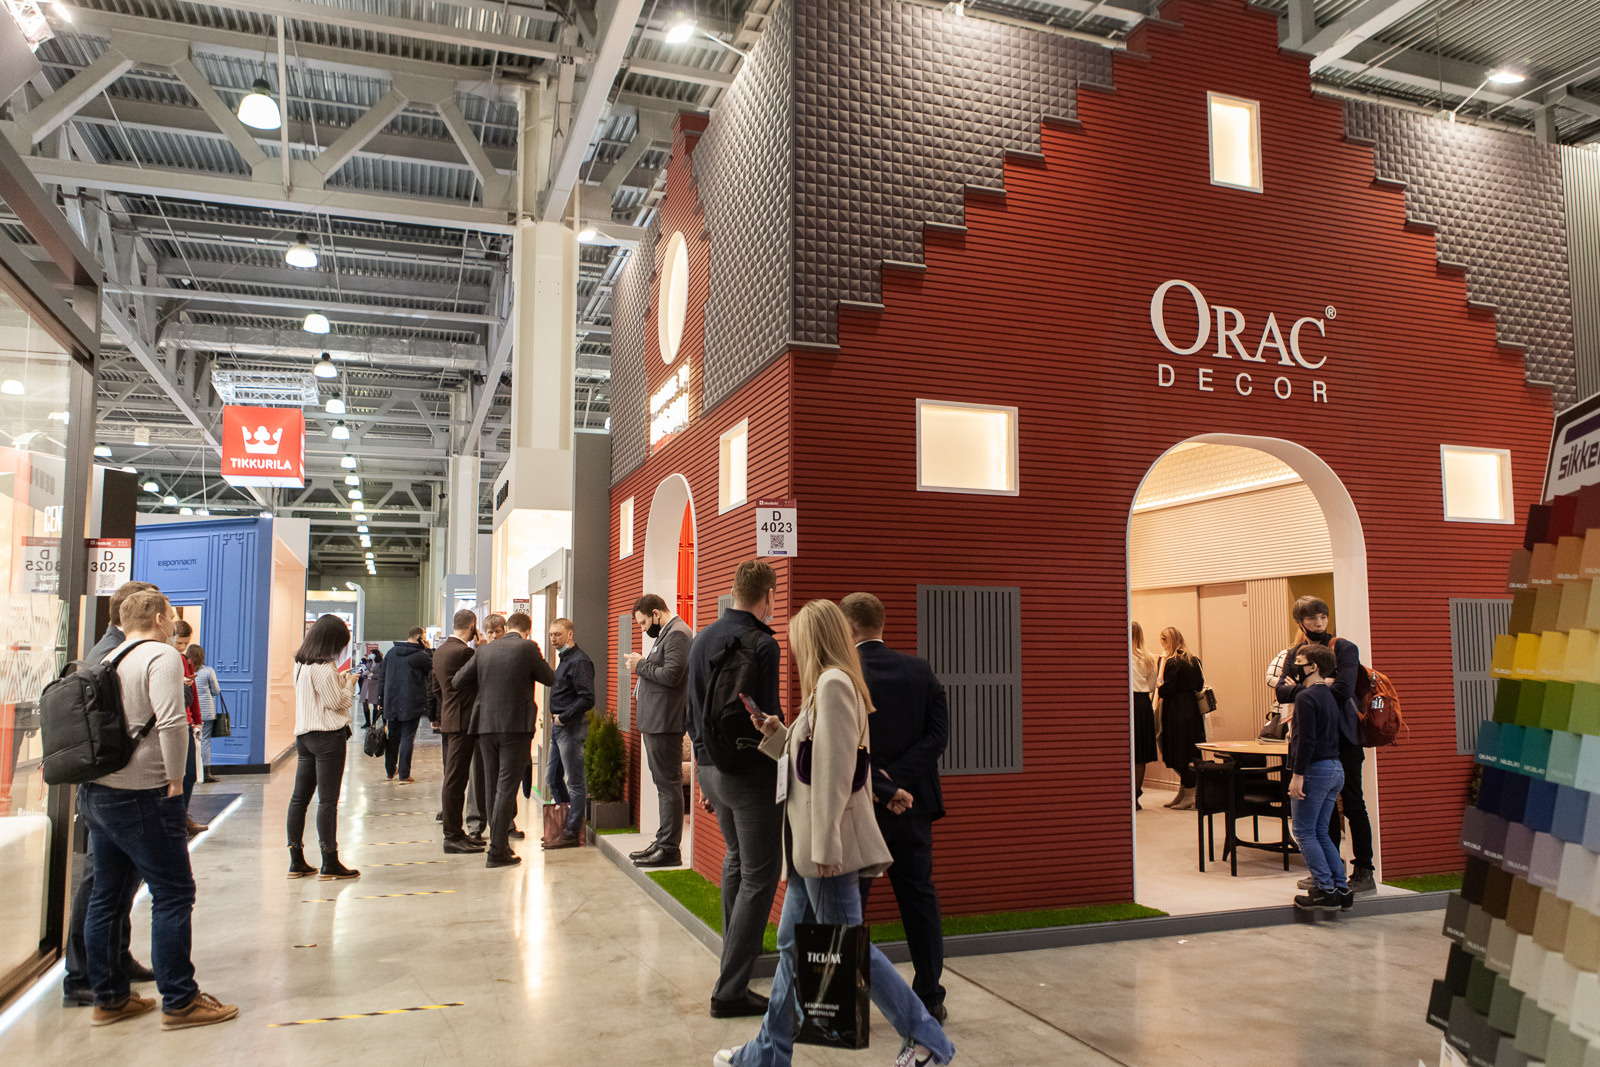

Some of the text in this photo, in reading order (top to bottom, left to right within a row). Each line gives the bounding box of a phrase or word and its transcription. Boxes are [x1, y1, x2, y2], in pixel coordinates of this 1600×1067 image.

[1158, 363, 1328, 404] DECOR
[229, 457, 293, 471] TIKKURILA
[772, 510, 782, 521] D
[761, 522, 793, 533] 4023
[104, 550, 114, 561] D
[90, 561, 126, 573] 3025
